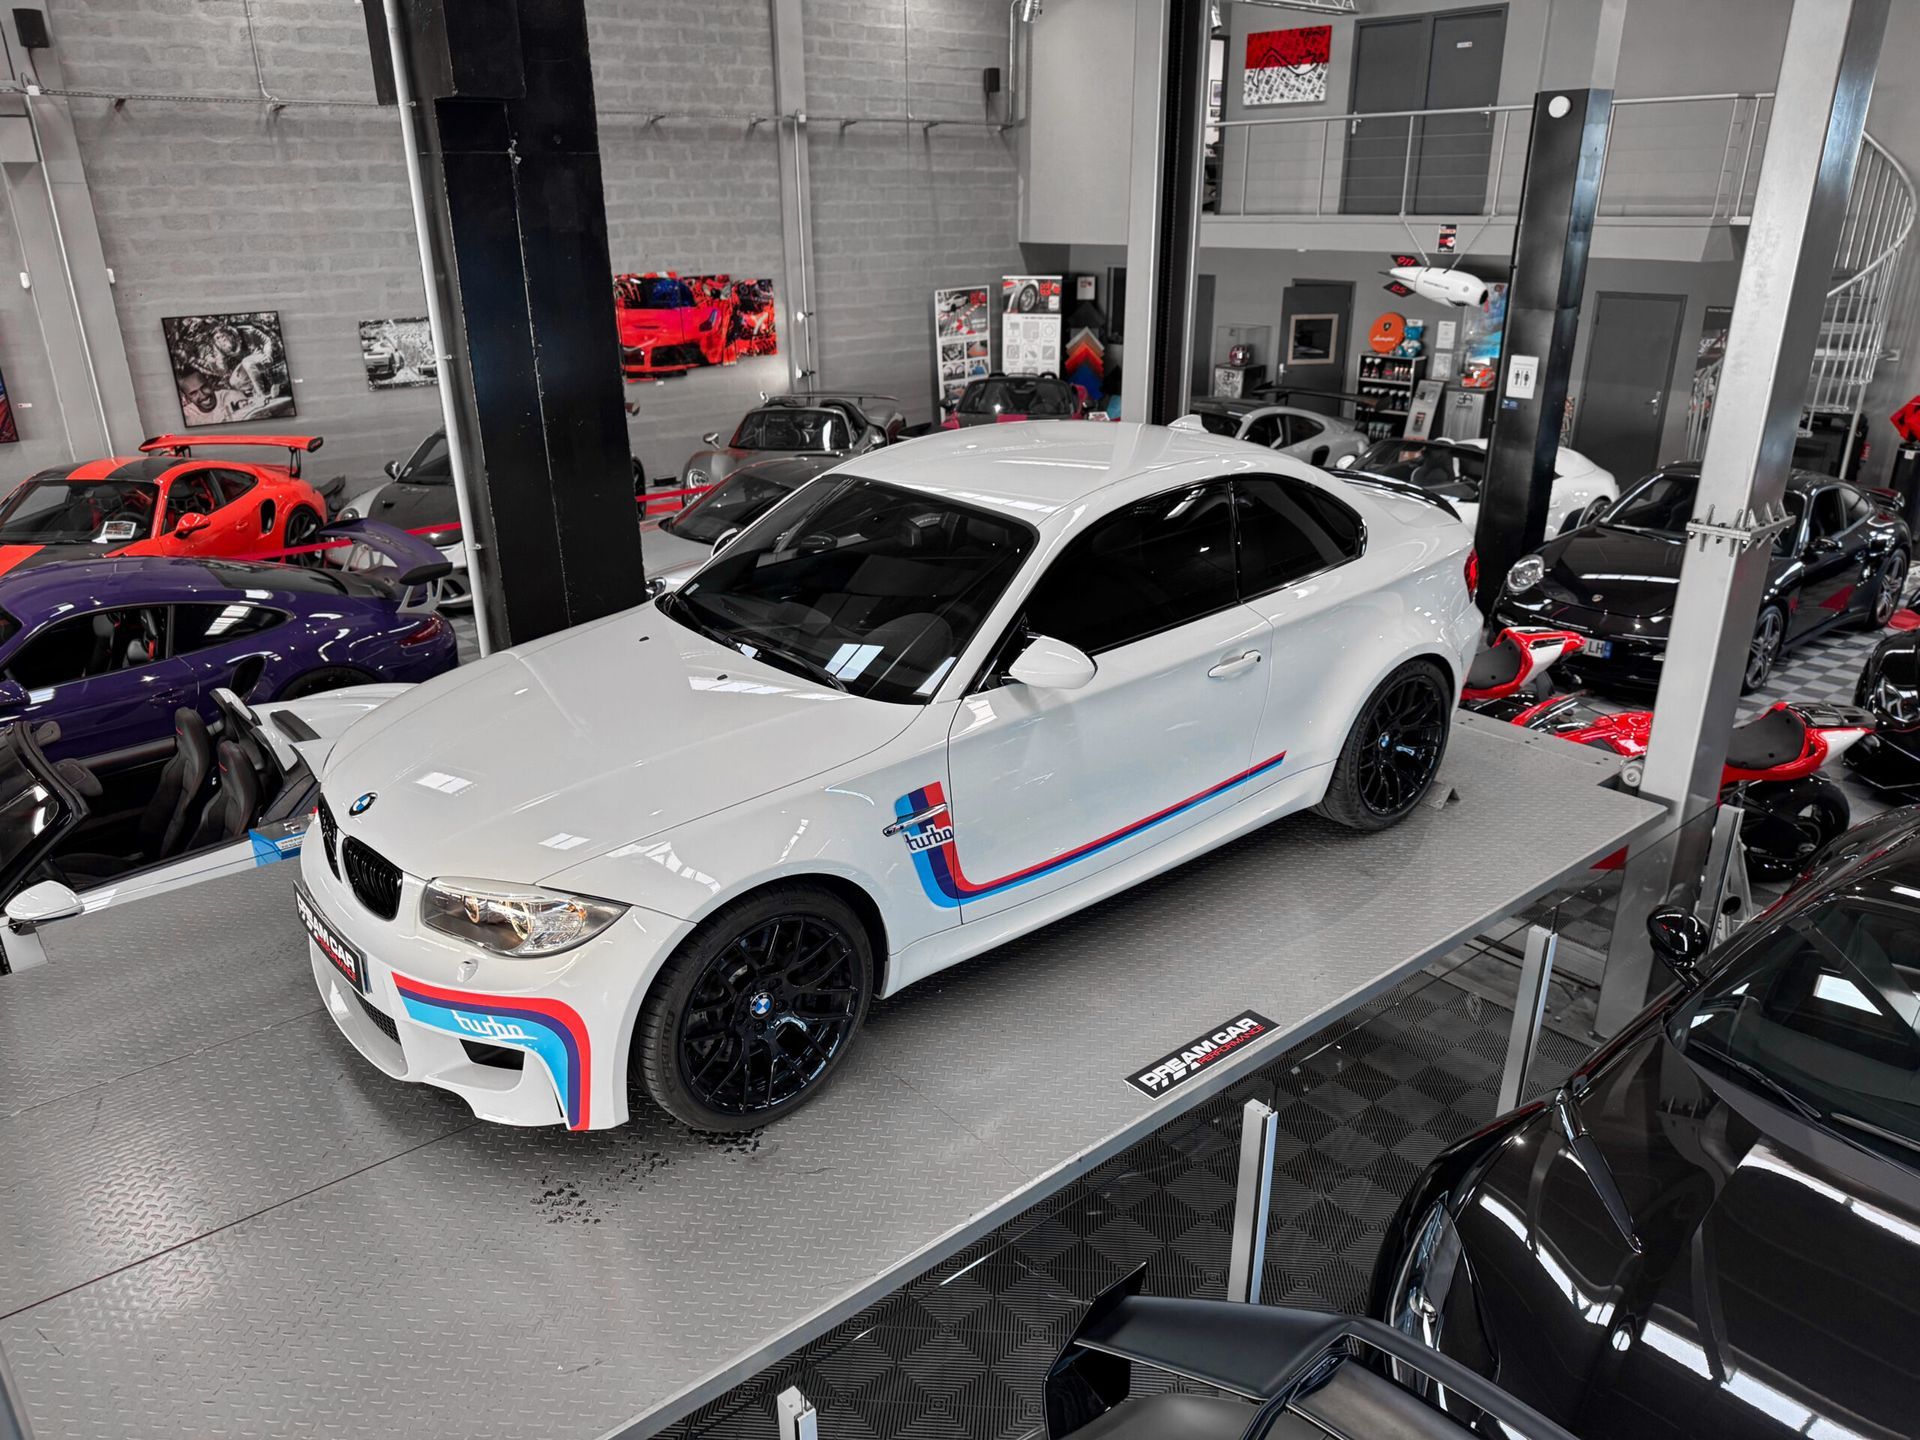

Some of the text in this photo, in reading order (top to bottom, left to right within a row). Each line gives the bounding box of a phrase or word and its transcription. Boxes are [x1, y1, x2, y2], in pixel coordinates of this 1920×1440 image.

[904, 827, 954, 851] turbo
[330, 936, 356, 973] CAR
[450, 1009, 530, 1040] turbo
[1138, 1017, 1259, 1088] DREAM CAR
[1199, 1024, 1266, 1065] PERFORMANCE
